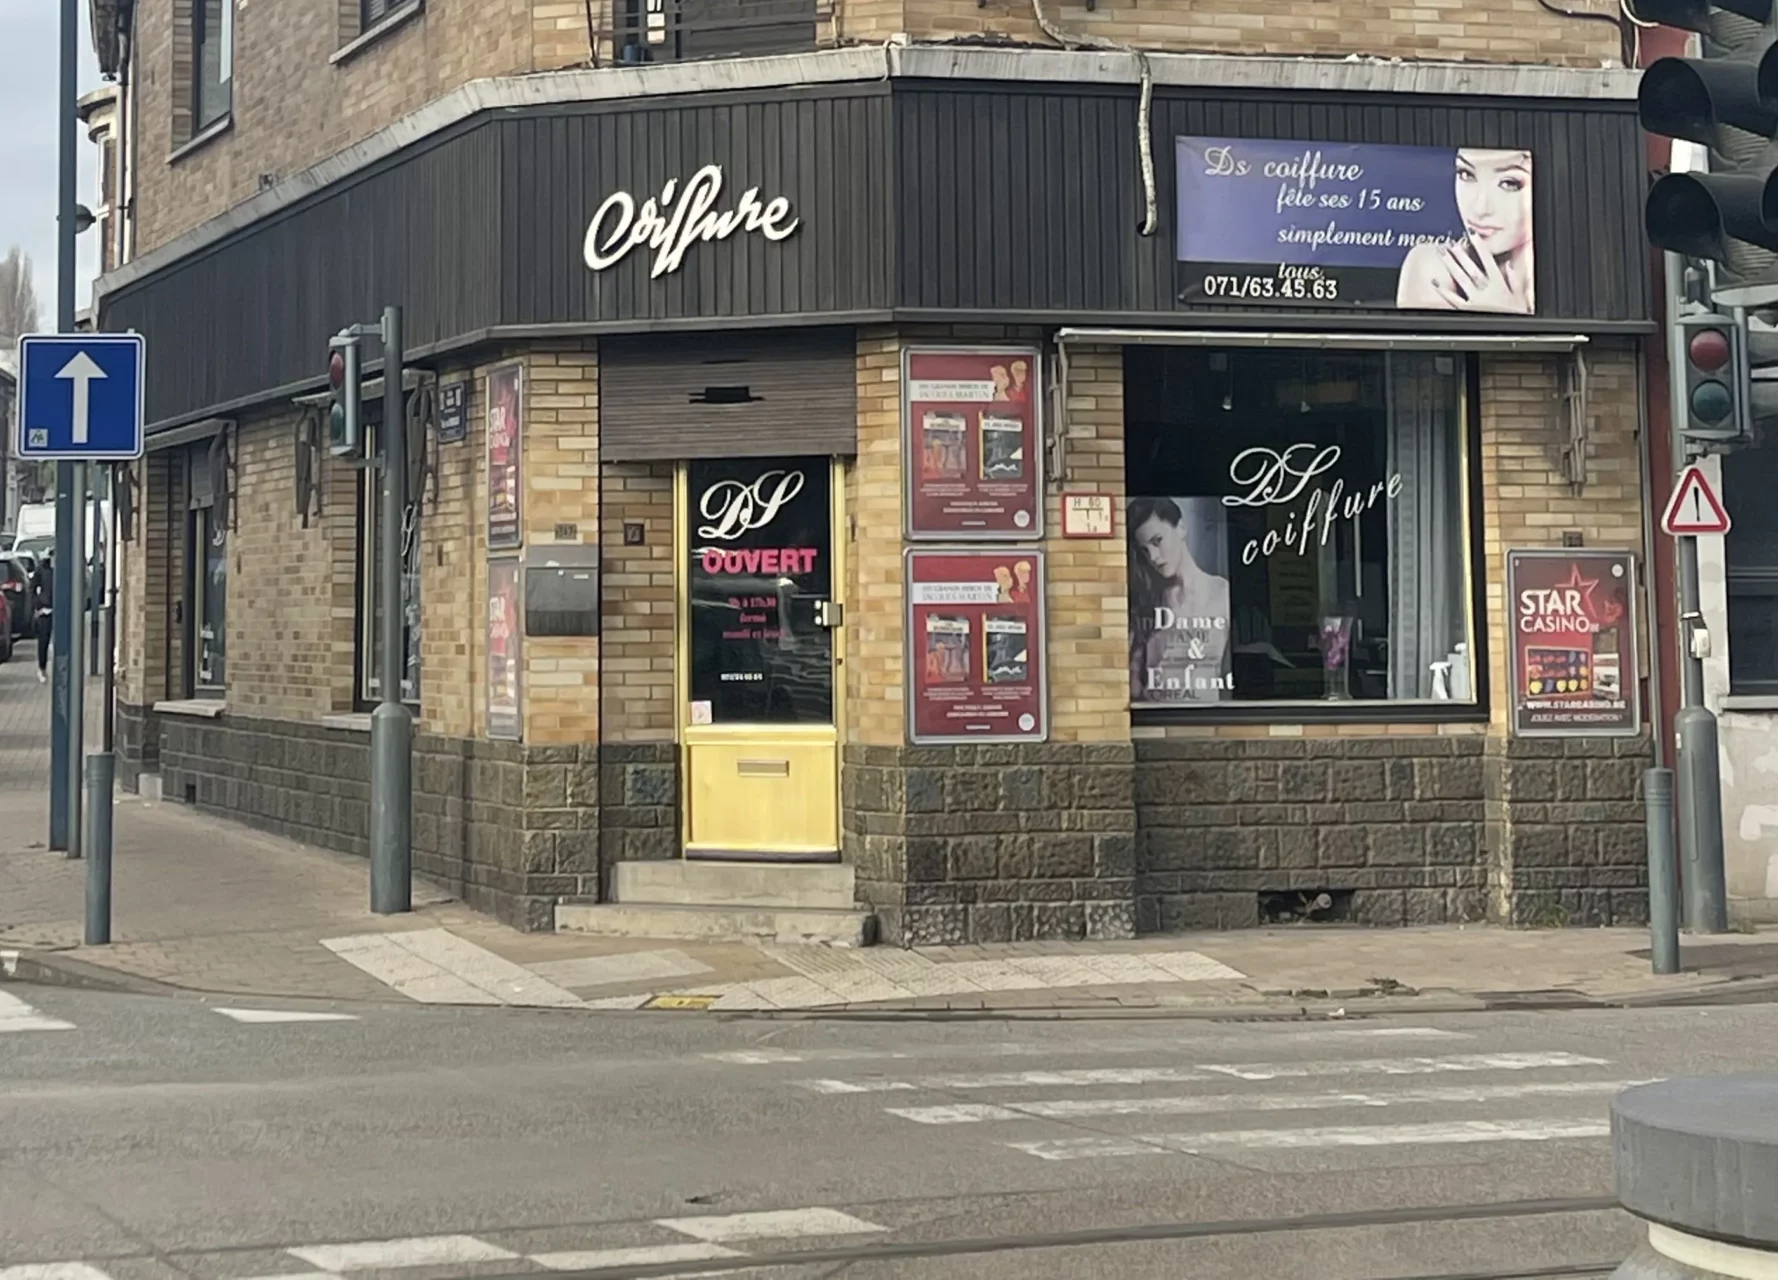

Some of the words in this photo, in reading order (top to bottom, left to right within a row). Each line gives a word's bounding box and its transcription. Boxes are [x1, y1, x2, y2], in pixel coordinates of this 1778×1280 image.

[1204, 146, 1251, 176] Ds
[1263, 150, 1364, 190] coiffure
[1276, 183, 1316, 213] fête
[1318, 194, 1351, 209] ses
[1357, 189, 1381, 210] 15
[1386, 197, 1425, 212] ans
[583, 164, 799, 279] Coiffure
[1277, 221, 1395, 252] simplement
[1204, 275, 1338, 300] 071/63.45.63
[1074, 497, 1081, 507] H
[1242, 472, 1404, 565] coiffure
[702, 548, 817, 575] OUVERT
[1520, 589, 1584, 615] STAR
[1154, 607, 1226, 630] Dame
[1187, 637, 1205, 659] &
[1147, 664, 1236, 690] Enfant
